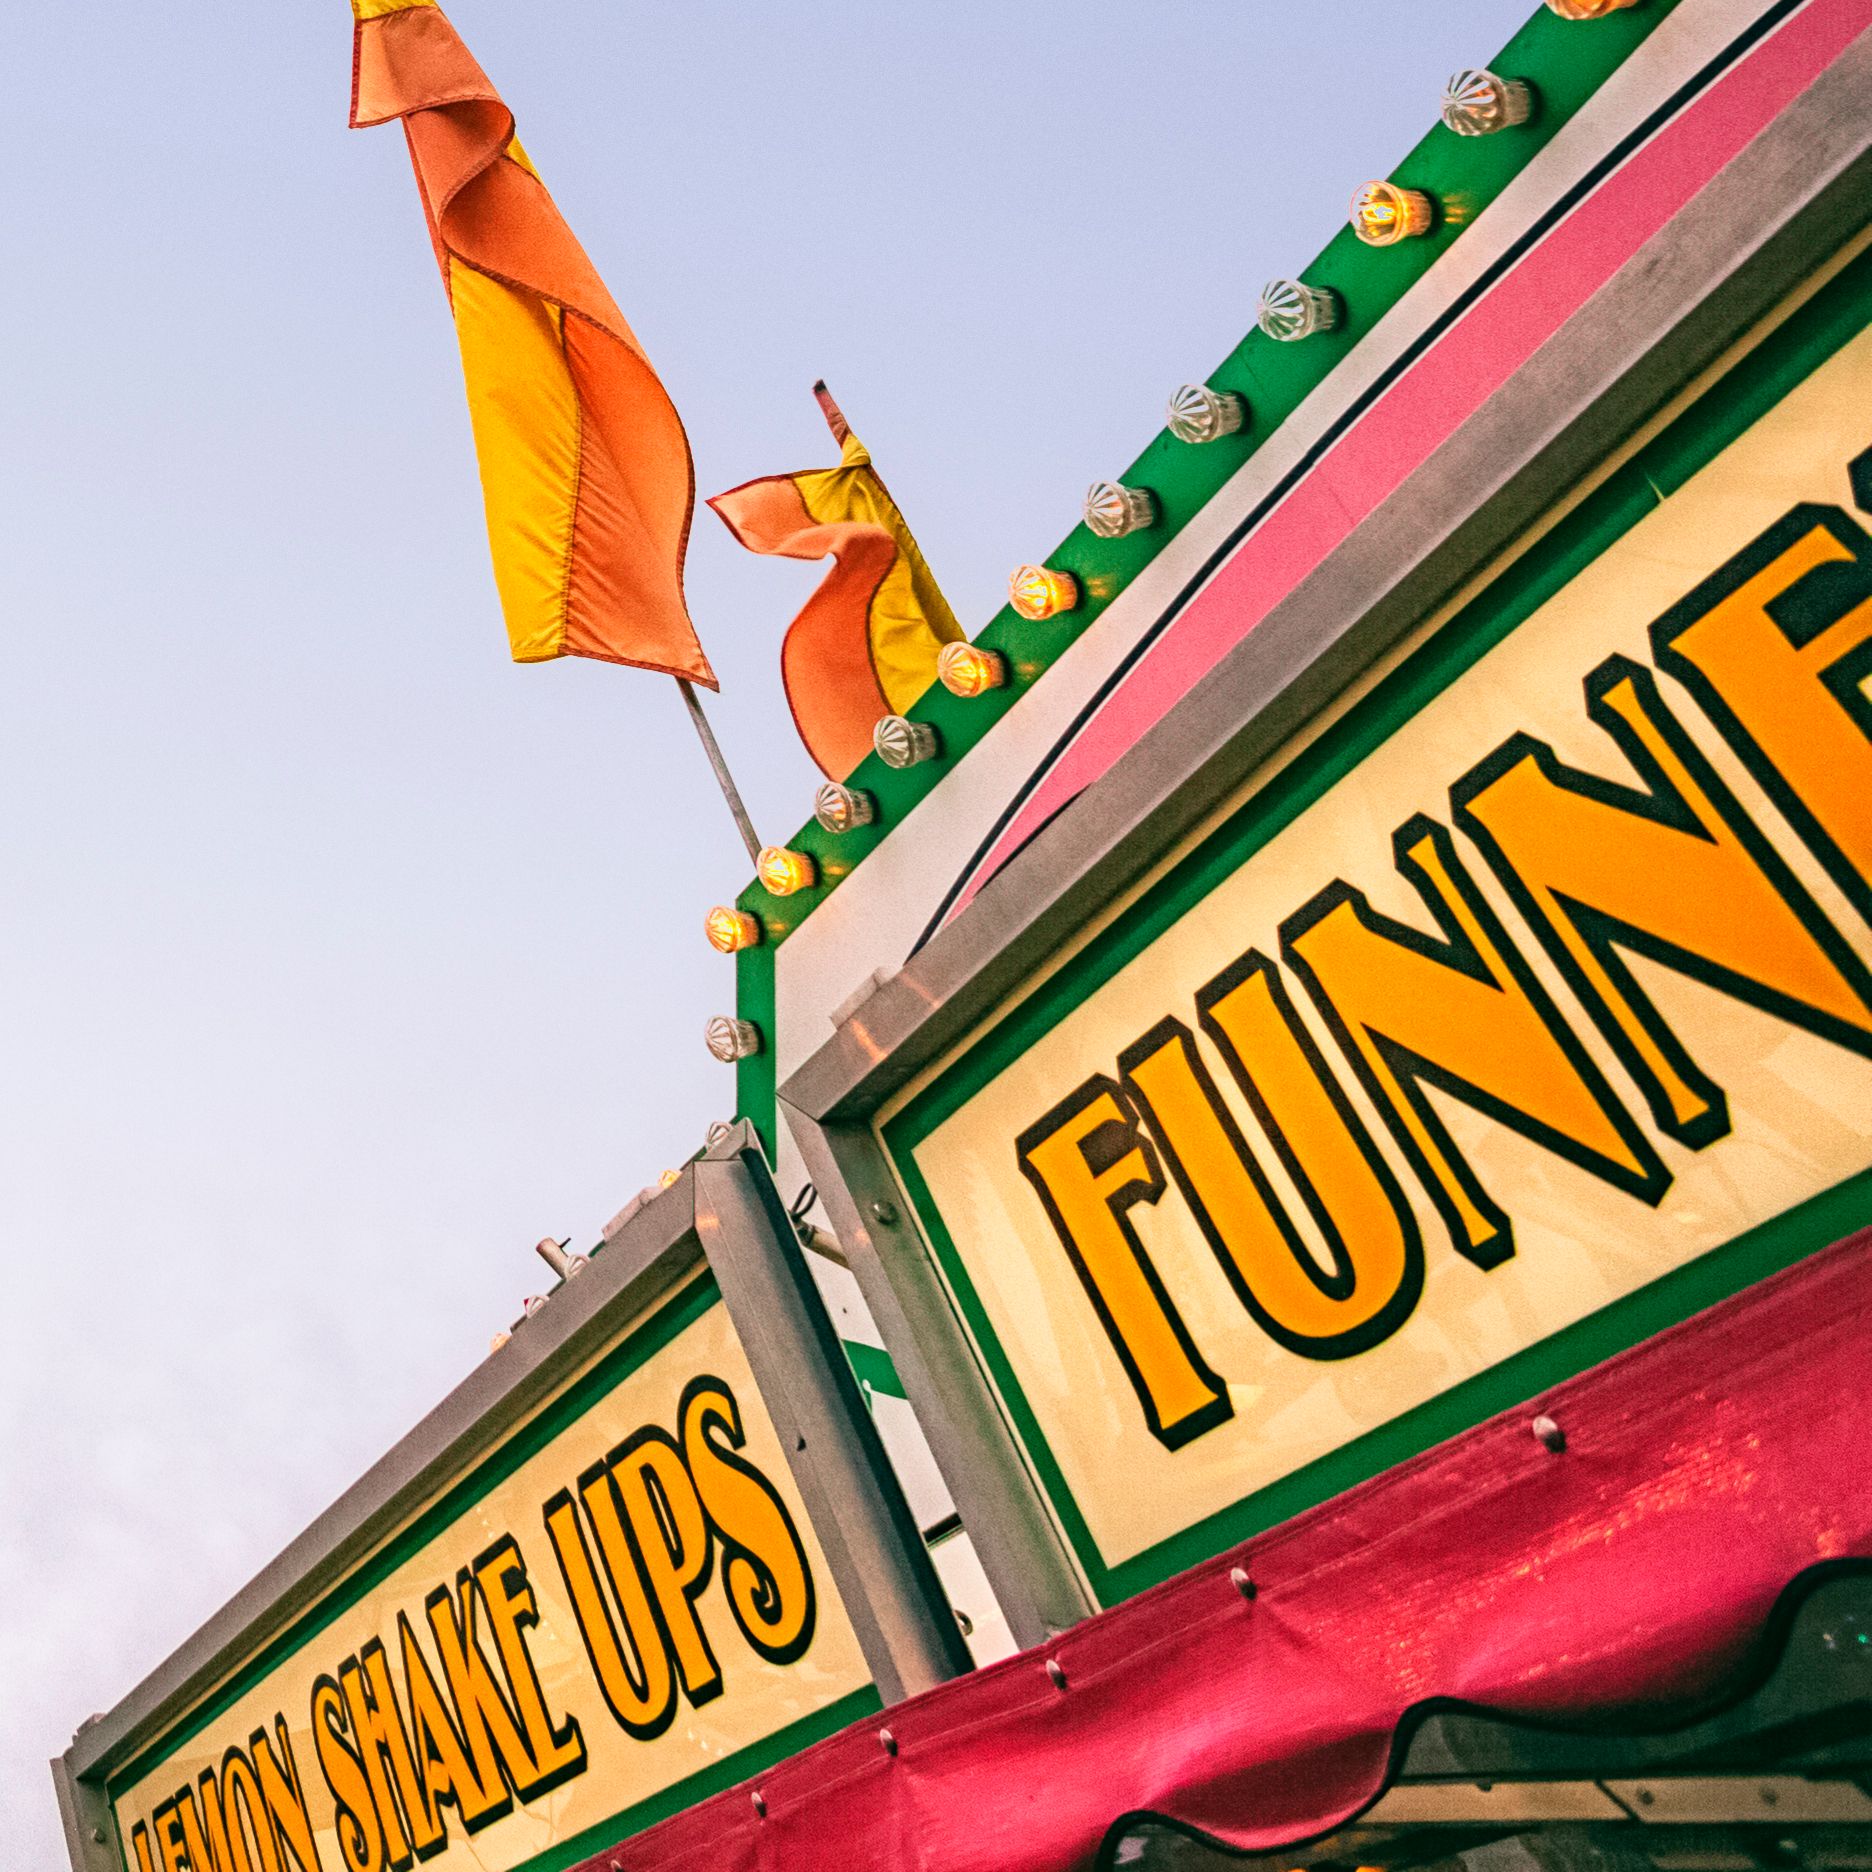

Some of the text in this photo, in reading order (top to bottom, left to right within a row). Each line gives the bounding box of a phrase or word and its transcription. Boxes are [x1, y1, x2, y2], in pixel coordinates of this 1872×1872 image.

[1018, 443, 1872, 1451] FUNNE
[311, 1533, 587, 1872] SHAKE
[544, 1374, 816, 1742] UPS
